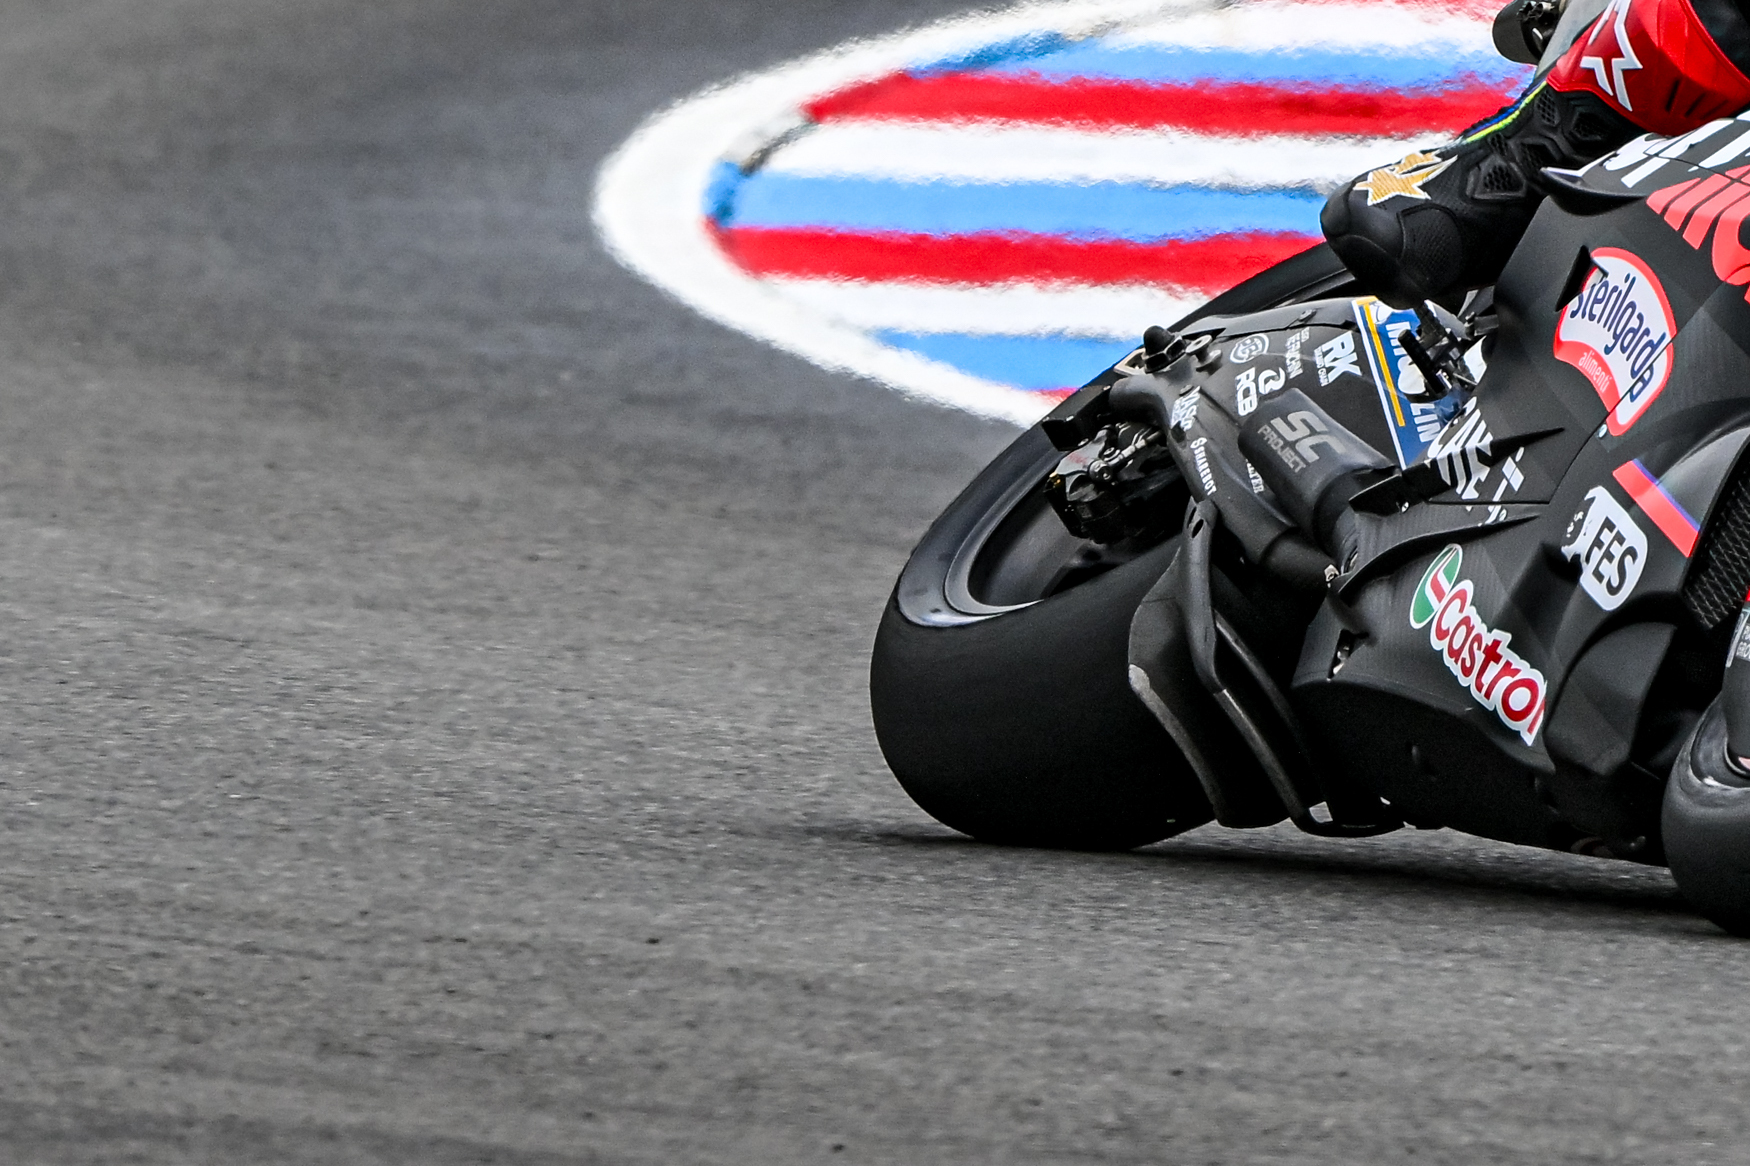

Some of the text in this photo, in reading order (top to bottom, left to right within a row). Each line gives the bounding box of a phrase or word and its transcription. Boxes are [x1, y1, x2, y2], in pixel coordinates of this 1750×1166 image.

[1321, 331, 1363, 384] RK
[1578, 350, 1613, 393] alimenti
[1235, 366, 1258, 417] RCB
[1257, 424, 1307, 474] PROJECT
[1273, 411, 1344, 464] SC
[1434, 589, 1546, 736] Castrol
